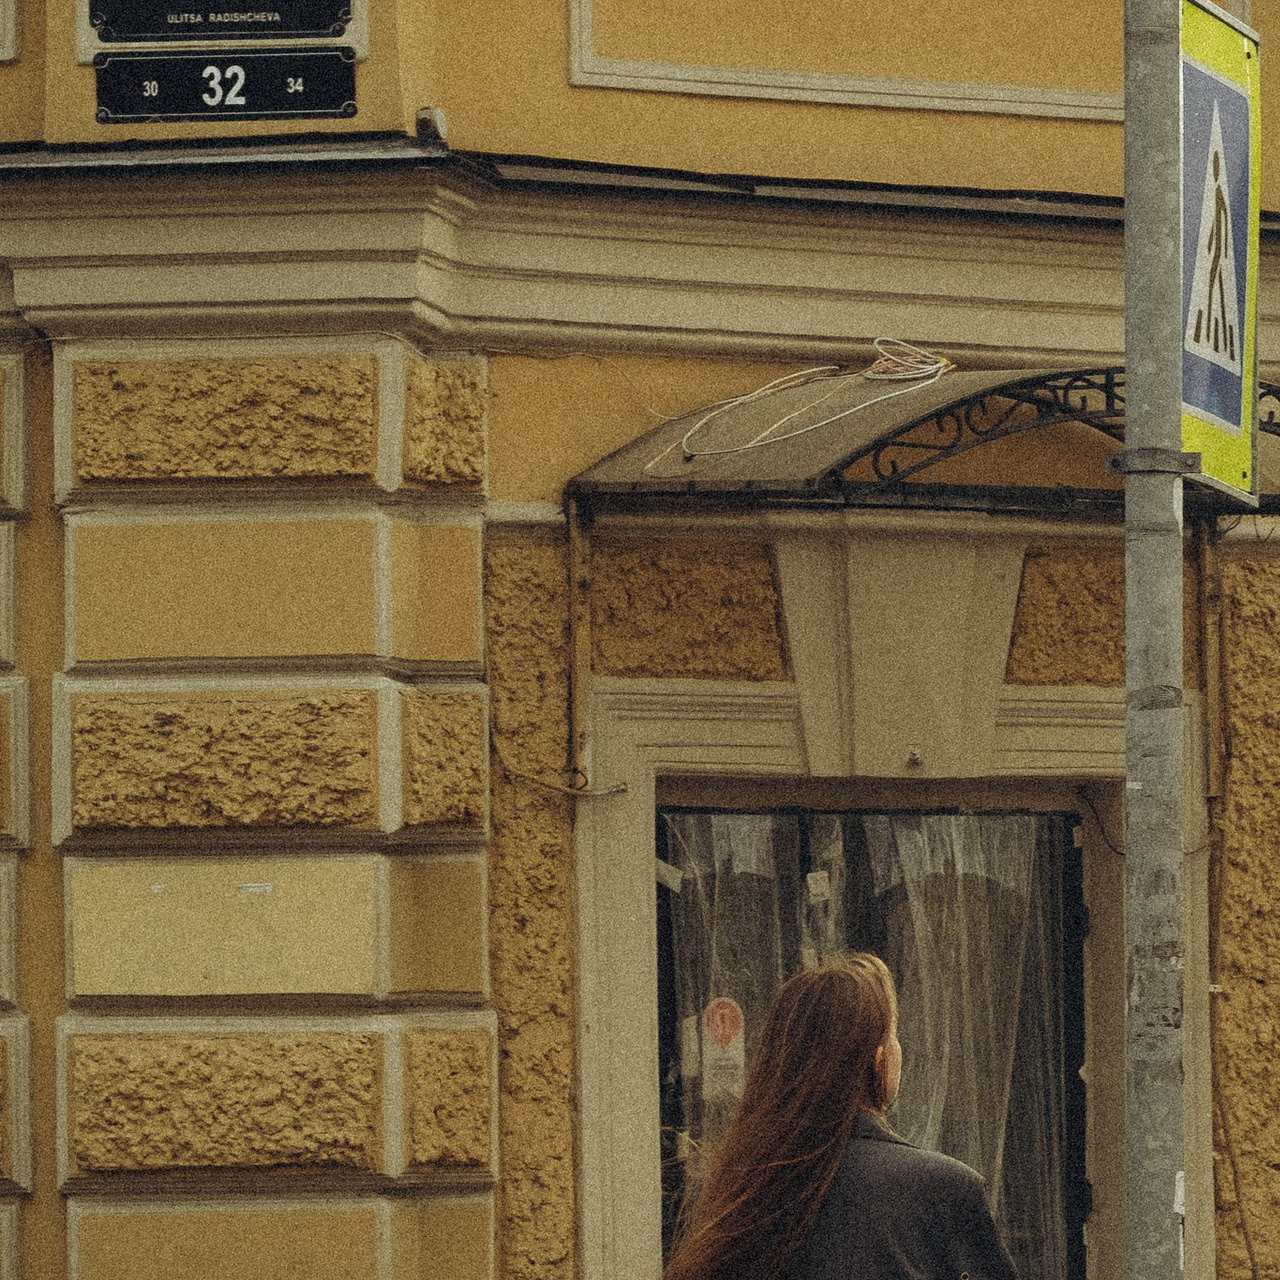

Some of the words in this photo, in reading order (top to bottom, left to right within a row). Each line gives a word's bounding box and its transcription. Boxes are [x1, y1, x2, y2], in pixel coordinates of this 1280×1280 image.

[167, 13, 203, 24] ULITSA
[209, 12, 281, 23] RADISHCHEVA
[142, 80, 158, 97] 30
[201, 64, 247, 106] 32
[286, 77, 304, 93] 34
